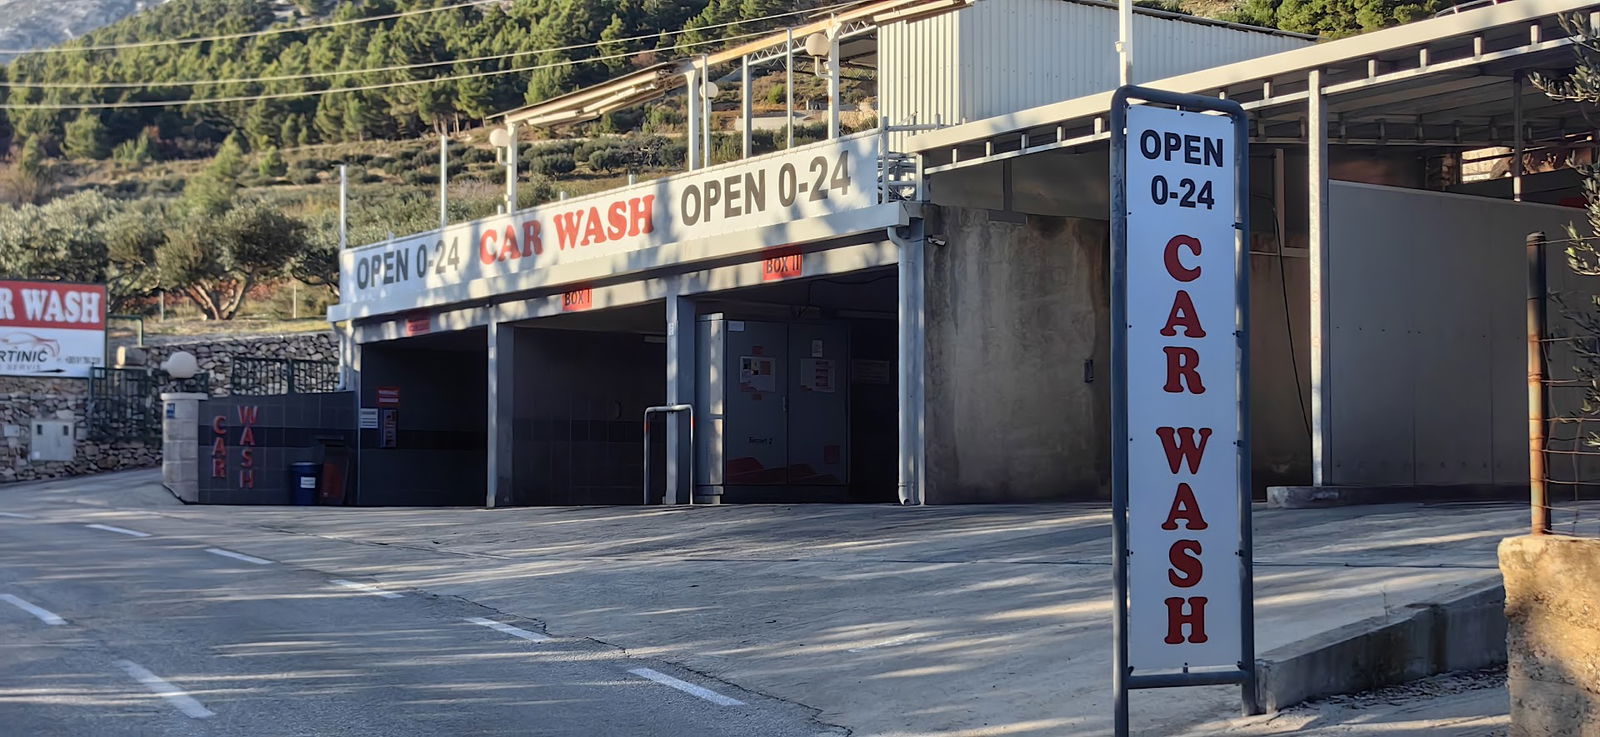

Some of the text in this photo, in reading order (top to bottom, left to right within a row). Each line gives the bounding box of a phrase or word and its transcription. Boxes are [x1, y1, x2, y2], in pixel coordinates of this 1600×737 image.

[1140, 129, 1223, 167] OPEN
[1151, 175, 1215, 210] 0-24
[357, 150, 851, 290] OPEN 0-24 CAR WASH OPEN 0-24
[767, 257, 788, 273] BOX
[20, 288, 101, 323] WASH
[564, 289, 584, 306] BOX
[212, 415, 227, 478] CAR
[237, 405, 258, 488] WASH
[1155, 234, 1212, 645] CAR WASH
